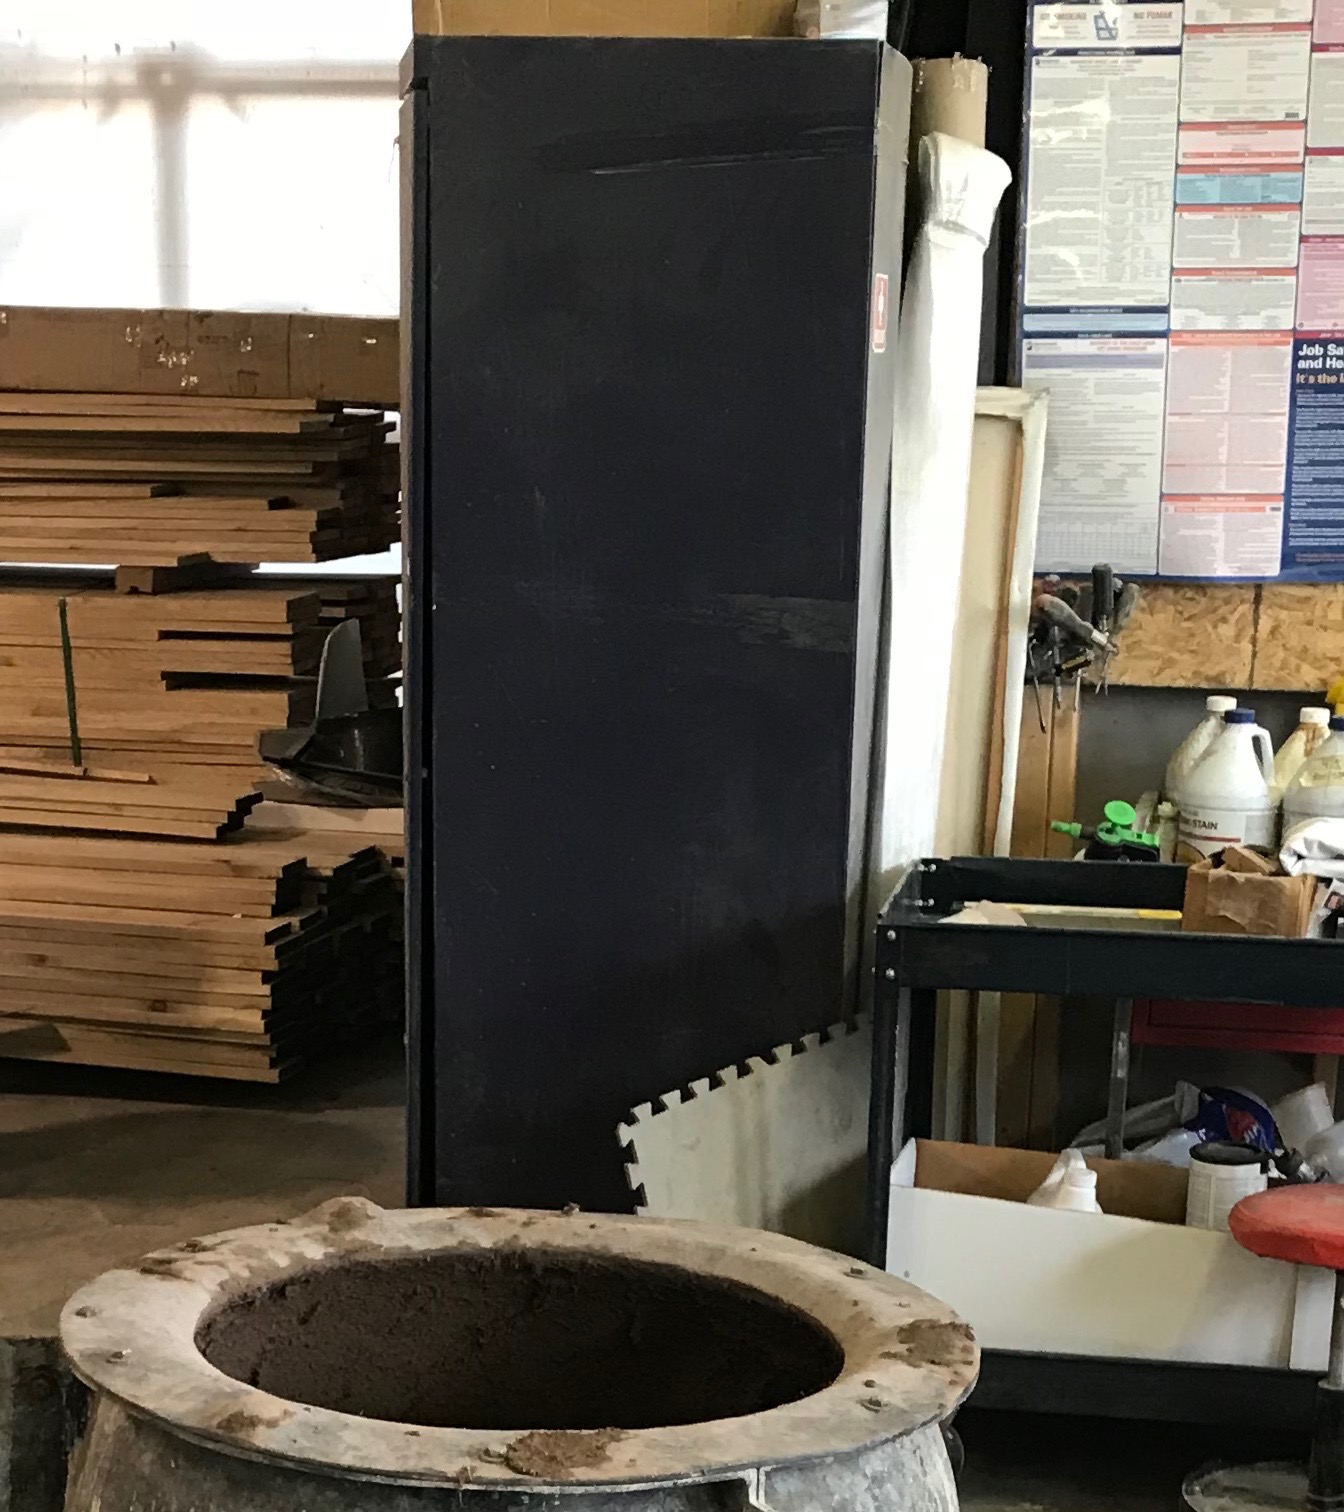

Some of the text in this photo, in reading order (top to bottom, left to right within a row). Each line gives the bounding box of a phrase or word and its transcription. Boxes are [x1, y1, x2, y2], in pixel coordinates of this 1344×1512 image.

[1298, 343, 1324, 356] Job
[1297, 357, 1323, 369] and
[1317, 373, 1338, 385] the
[1192, 819, 1219, 830] STAIN
